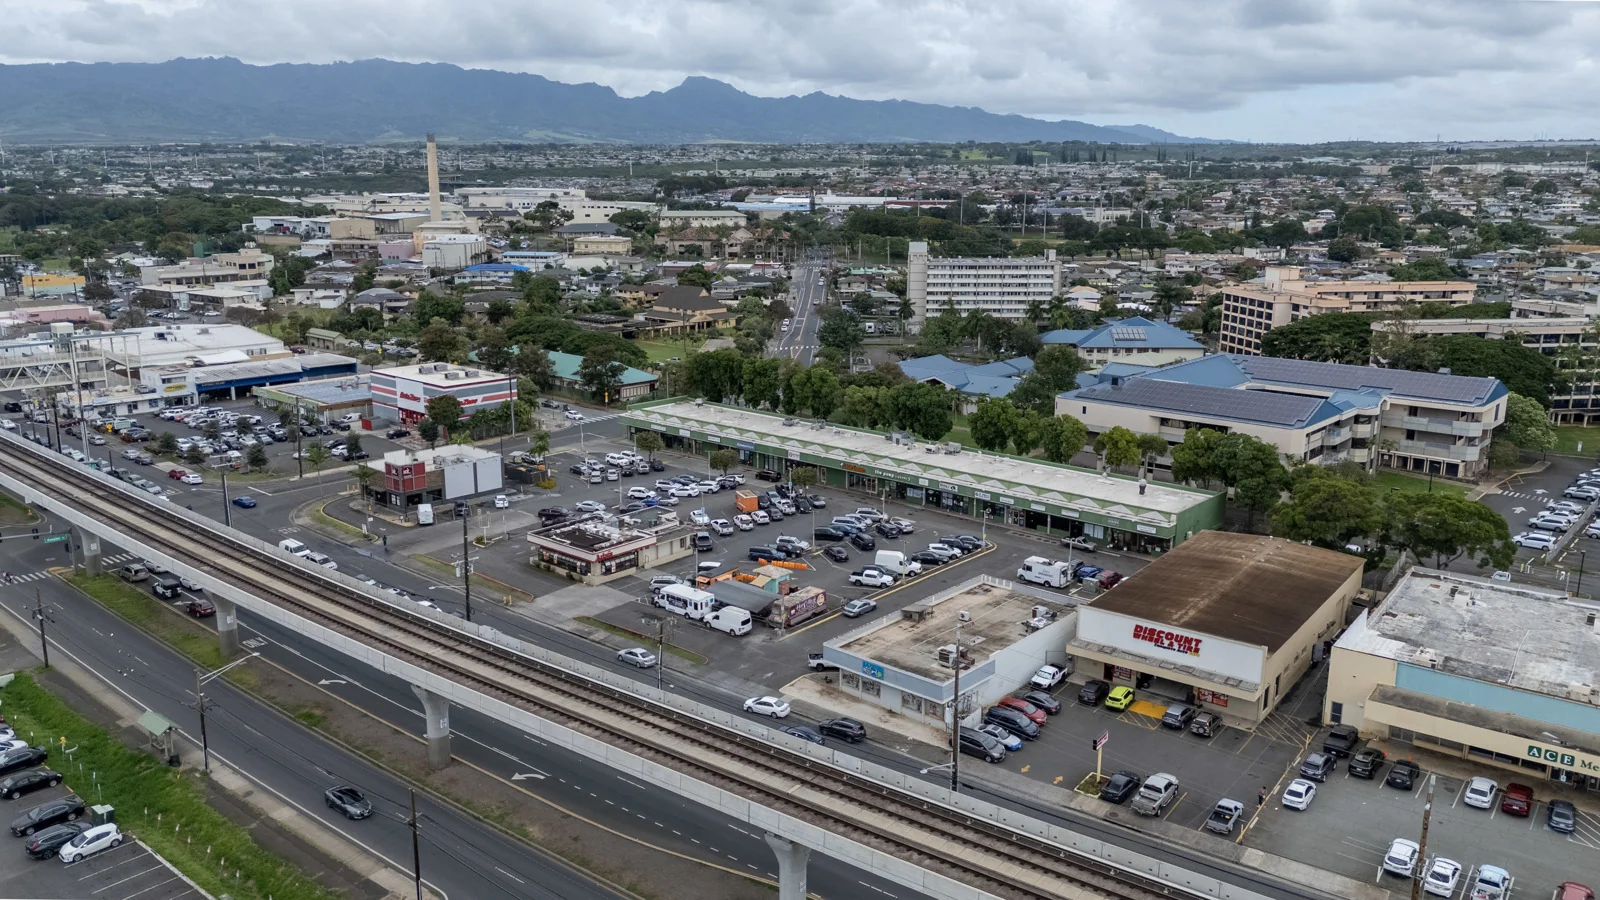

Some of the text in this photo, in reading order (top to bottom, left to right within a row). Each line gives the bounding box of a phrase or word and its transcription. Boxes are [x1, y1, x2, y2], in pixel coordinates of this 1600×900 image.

[1132, 632, 1164, 646] WHEEL
[1177, 642, 1200, 654] TIRE
[1133, 624, 1202, 648] DISCOUNT
[1529, 747, 1572, 765] ACE
